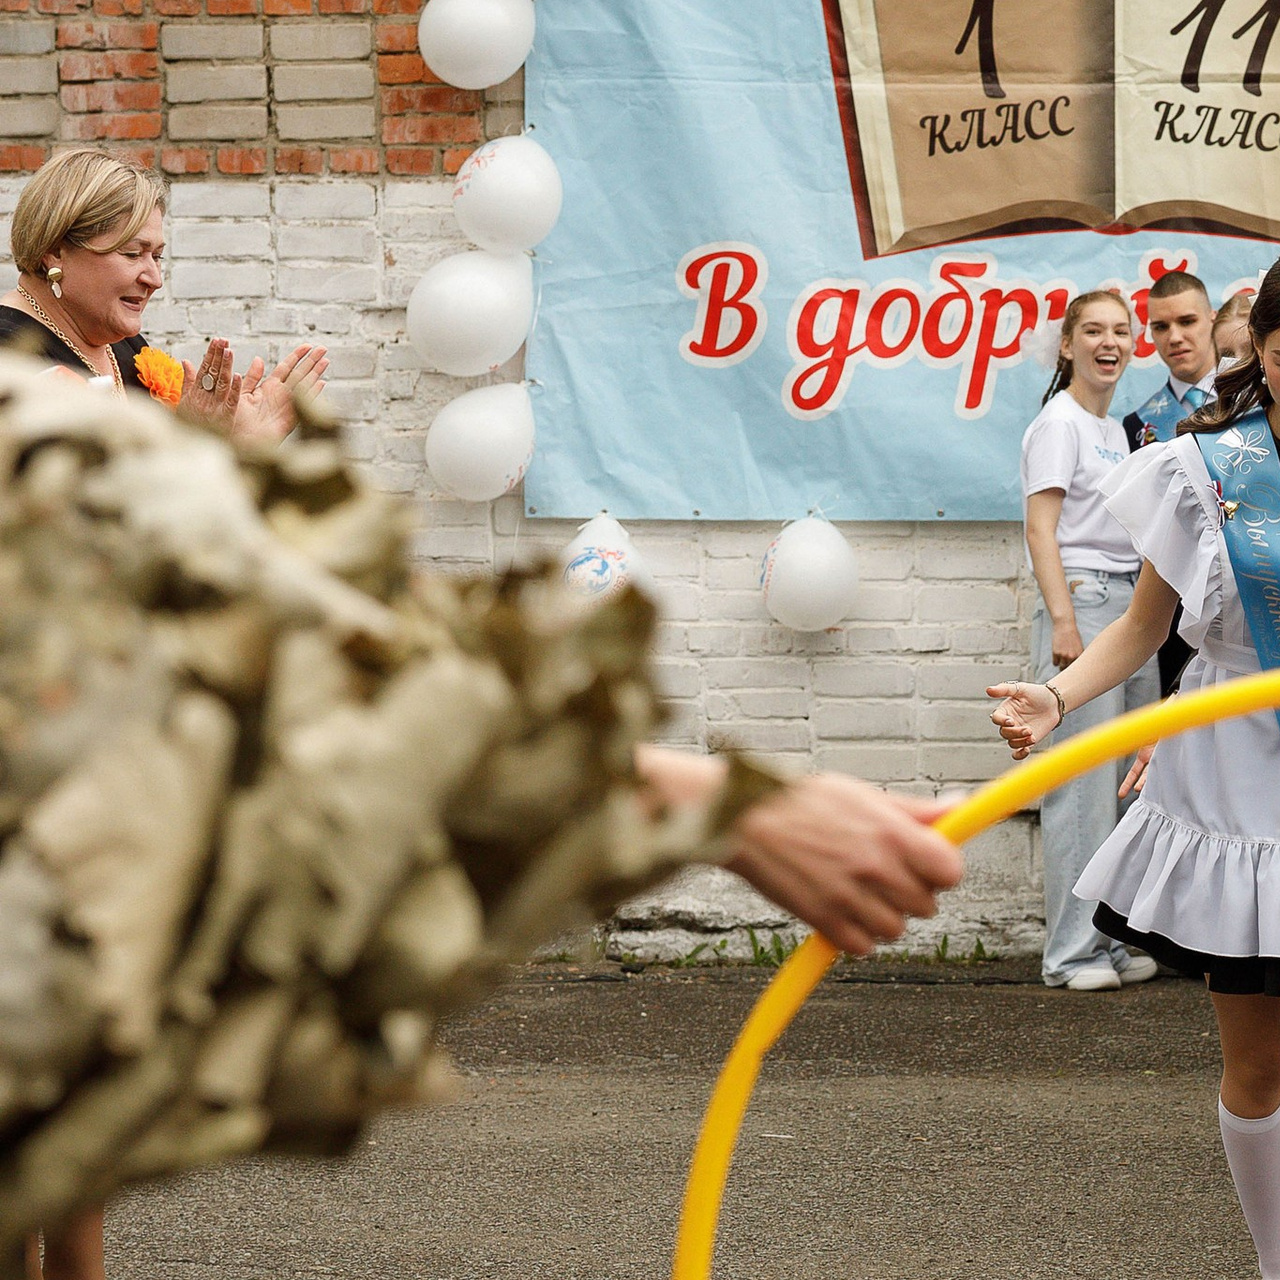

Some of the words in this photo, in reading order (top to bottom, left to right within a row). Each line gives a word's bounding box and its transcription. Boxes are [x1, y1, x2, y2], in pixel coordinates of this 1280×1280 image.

[919, 95, 1076, 158] КЛАСС
[685, 251, 758, 358] В
[791, 258, 1189, 411] добрй
